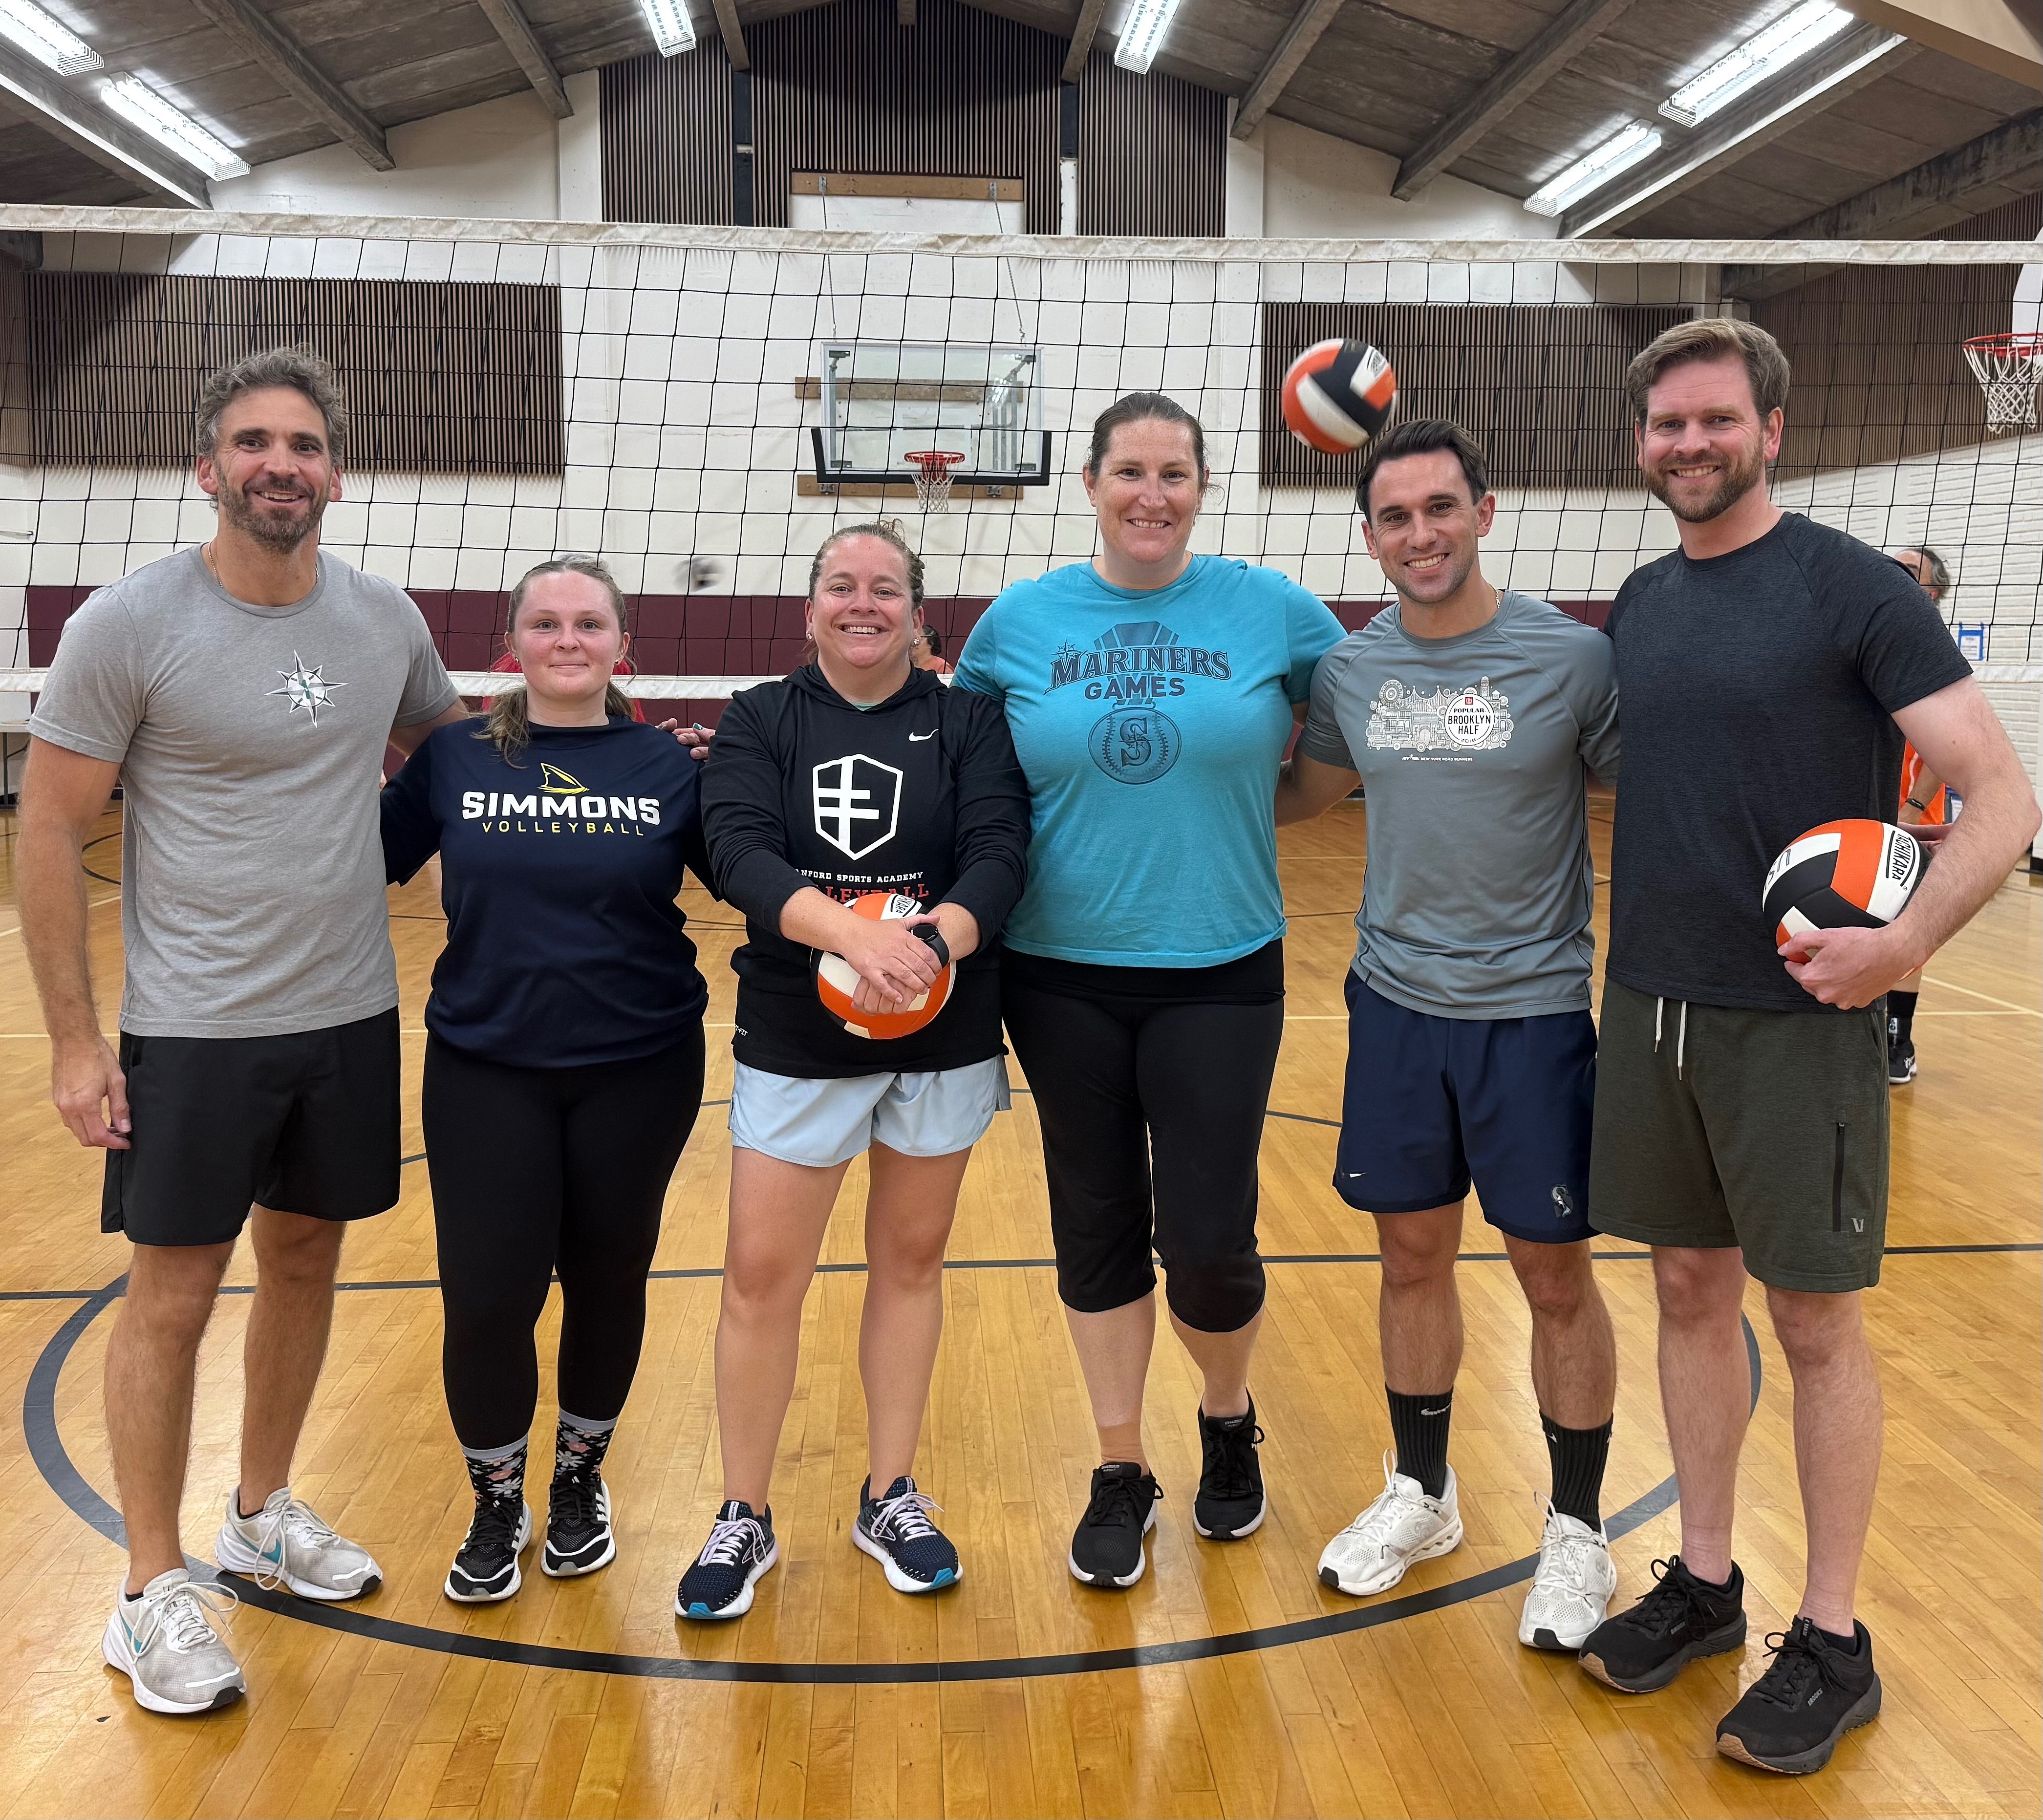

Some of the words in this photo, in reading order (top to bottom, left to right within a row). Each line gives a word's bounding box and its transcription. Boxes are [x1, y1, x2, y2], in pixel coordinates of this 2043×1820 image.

[1043, 646, 1231, 695] MARINERS
[1084, 677, 1185, 700] GAMES
[1448, 715, 1491, 724] BROOKLYN
[1458, 725, 1479, 734] HALF
[462, 791, 660, 825] SIMMONS
[482, 821, 644, 836] VOLLEYBALL
[796, 869, 832, 879] NFORD
[837, 874, 872, 882] SPORTS
[877, 872, 923, 883] ACADEMY
